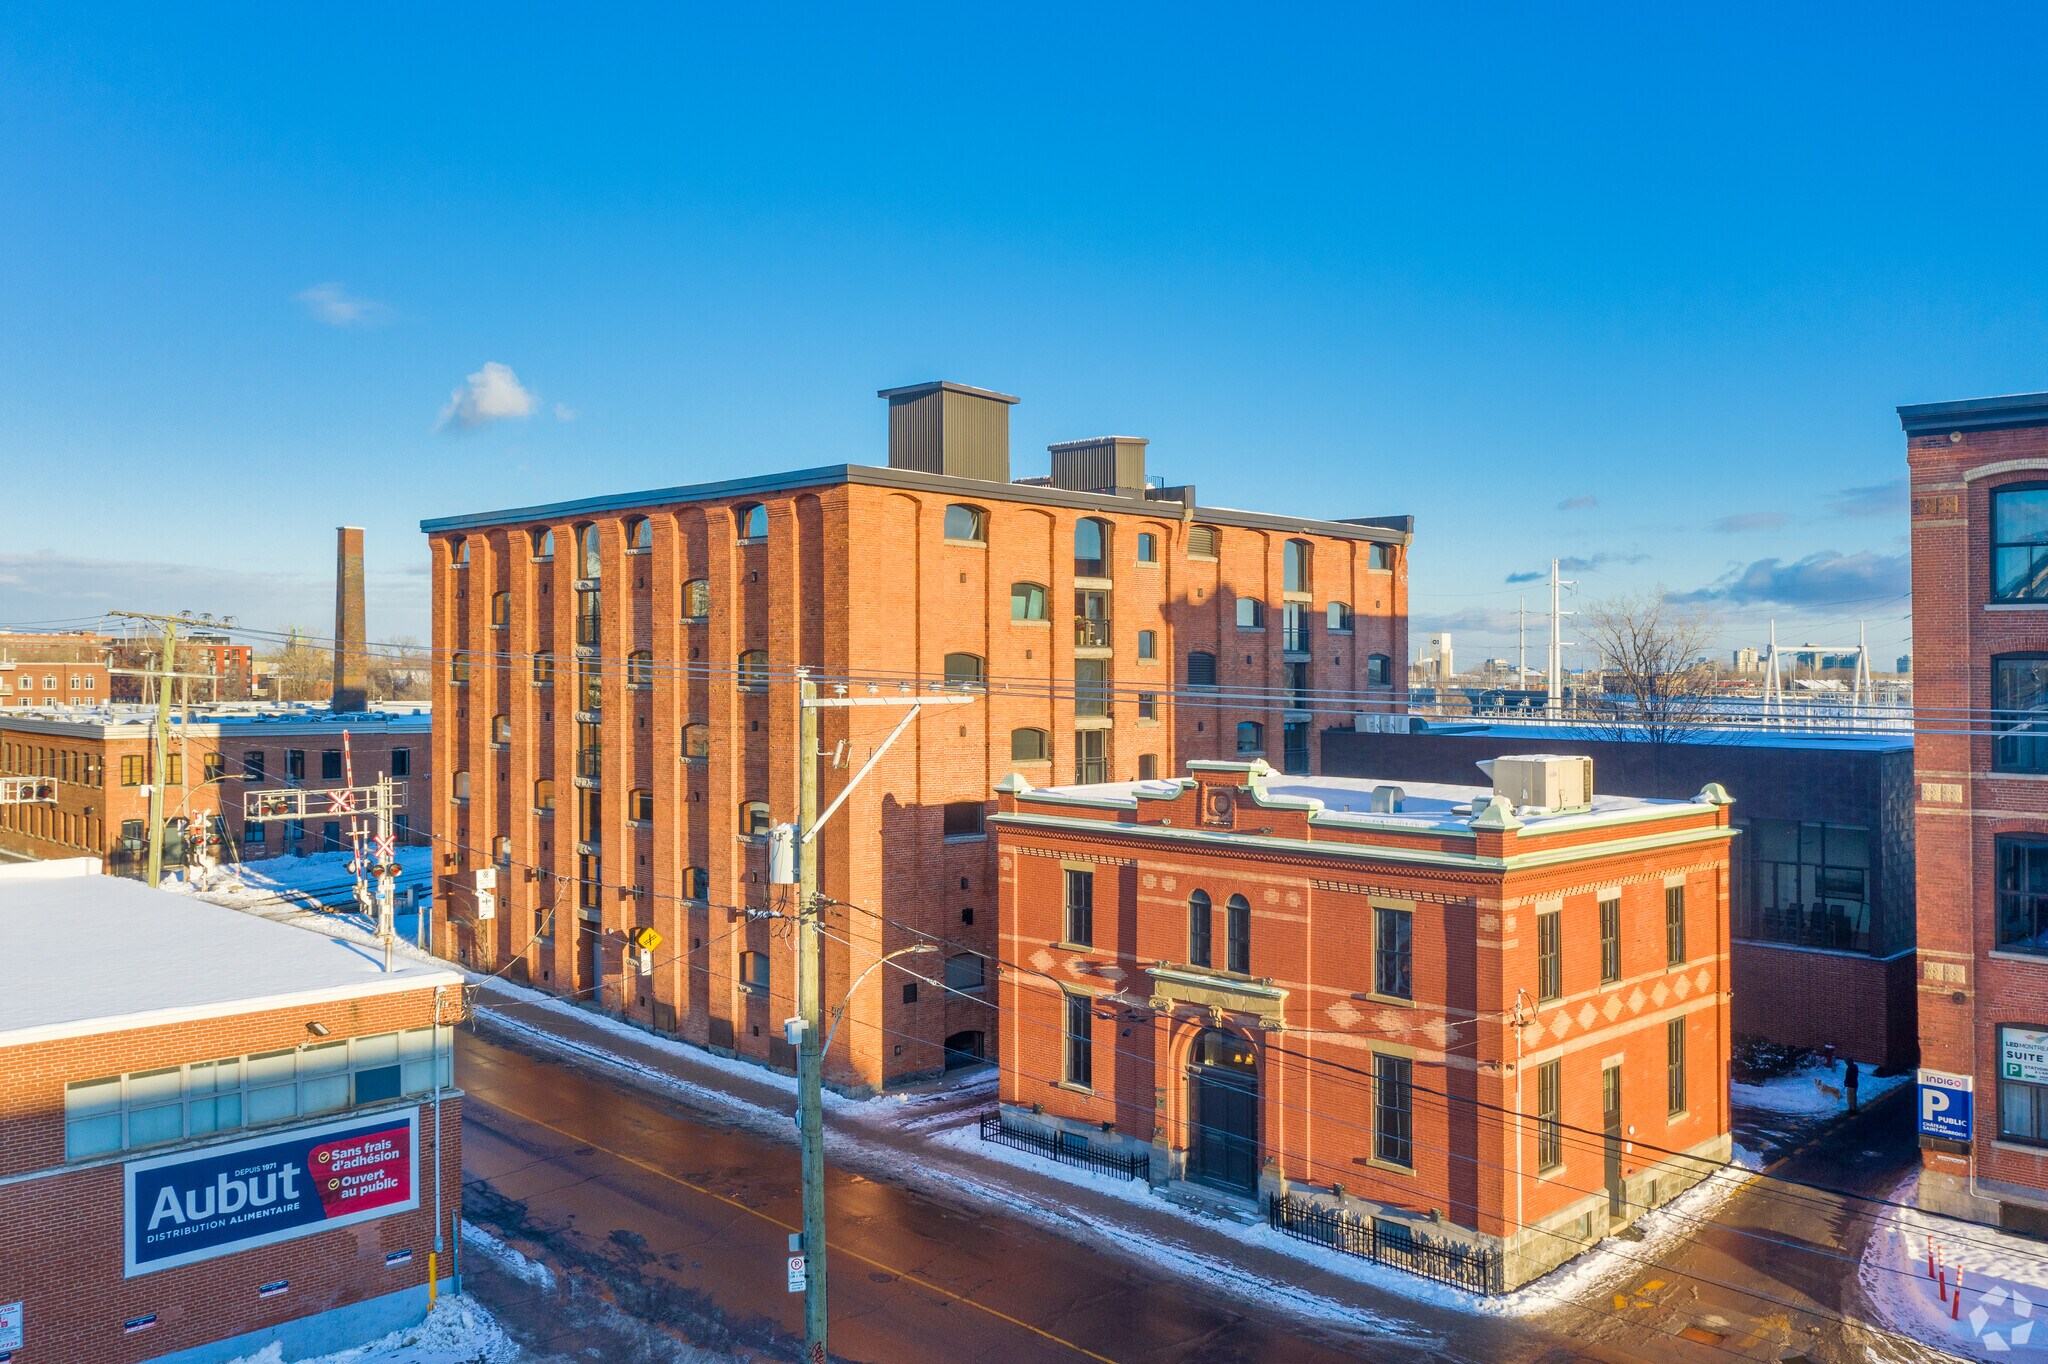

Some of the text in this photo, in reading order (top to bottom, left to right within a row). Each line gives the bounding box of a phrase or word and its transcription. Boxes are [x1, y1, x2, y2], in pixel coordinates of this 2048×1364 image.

[2005, 1041, 2048, 1051] LEDMONTRE
[2006, 1050, 2044, 1063] SUITE
[2009, 1064, 2020, 1075] P
[1926, 1075, 1962, 1088] INDIGO
[1922, 1088, 1950, 1121] P
[1938, 1116, 1967, 1127] PUBLIC
[1922, 1125, 1967, 1138] SAINT-AMBROISE
[331, 1139, 392, 1160] Sans frais
[331, 1149, 400, 1172] d'adhésion
[234, 1162, 277, 1177] DEPUIS 1971
[341, 1168, 385, 1187] Ouvert
[147, 1162, 301, 1231] Aubut
[341, 1178, 399, 1199] au public
[147, 1202, 300, 1244] DISTRIBUTION ALIMENTAIRE
